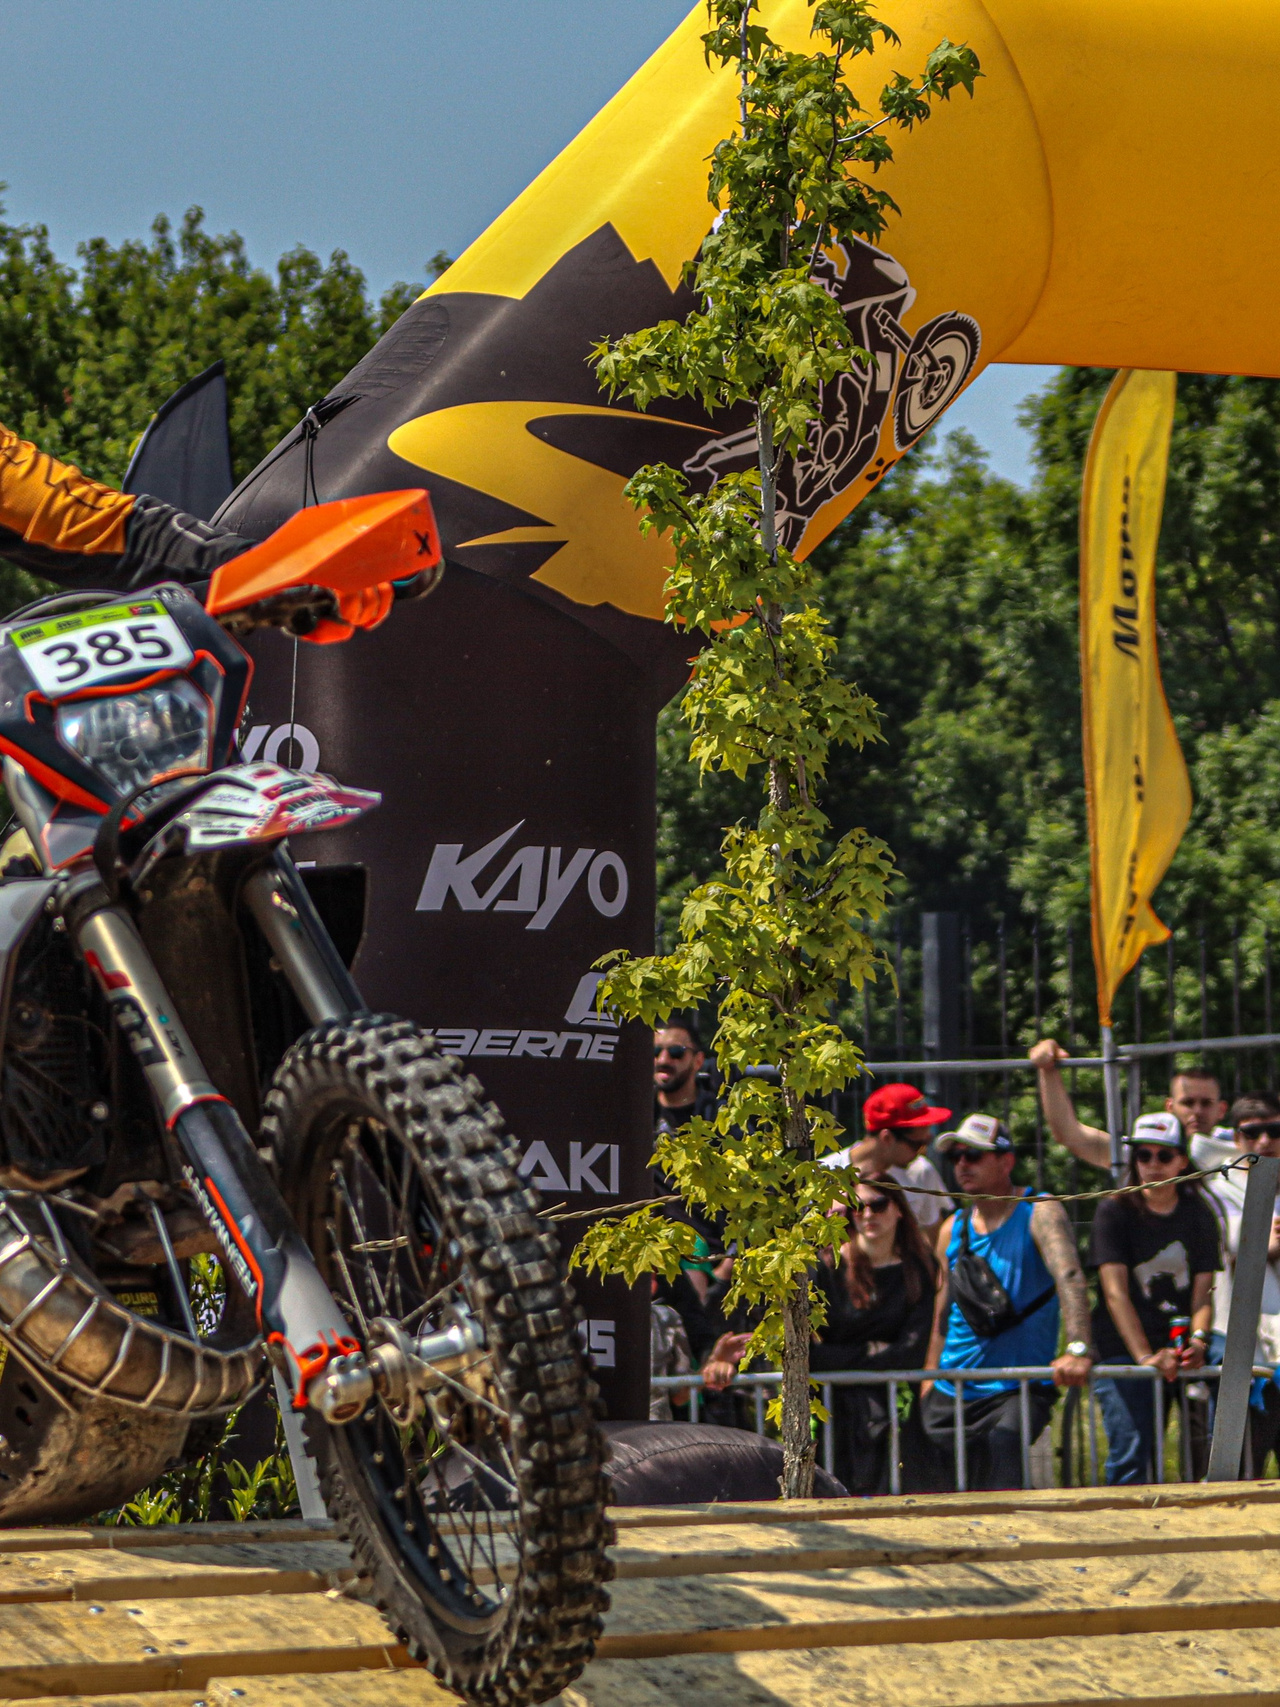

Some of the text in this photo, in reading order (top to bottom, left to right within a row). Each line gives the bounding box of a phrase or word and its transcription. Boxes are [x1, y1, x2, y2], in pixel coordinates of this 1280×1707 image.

[42, 623, 173, 683] 385
[415, 818, 628, 930] KAYO
[420, 1028, 619, 1061] AERNE
[517, 1140, 619, 1193] AKI
